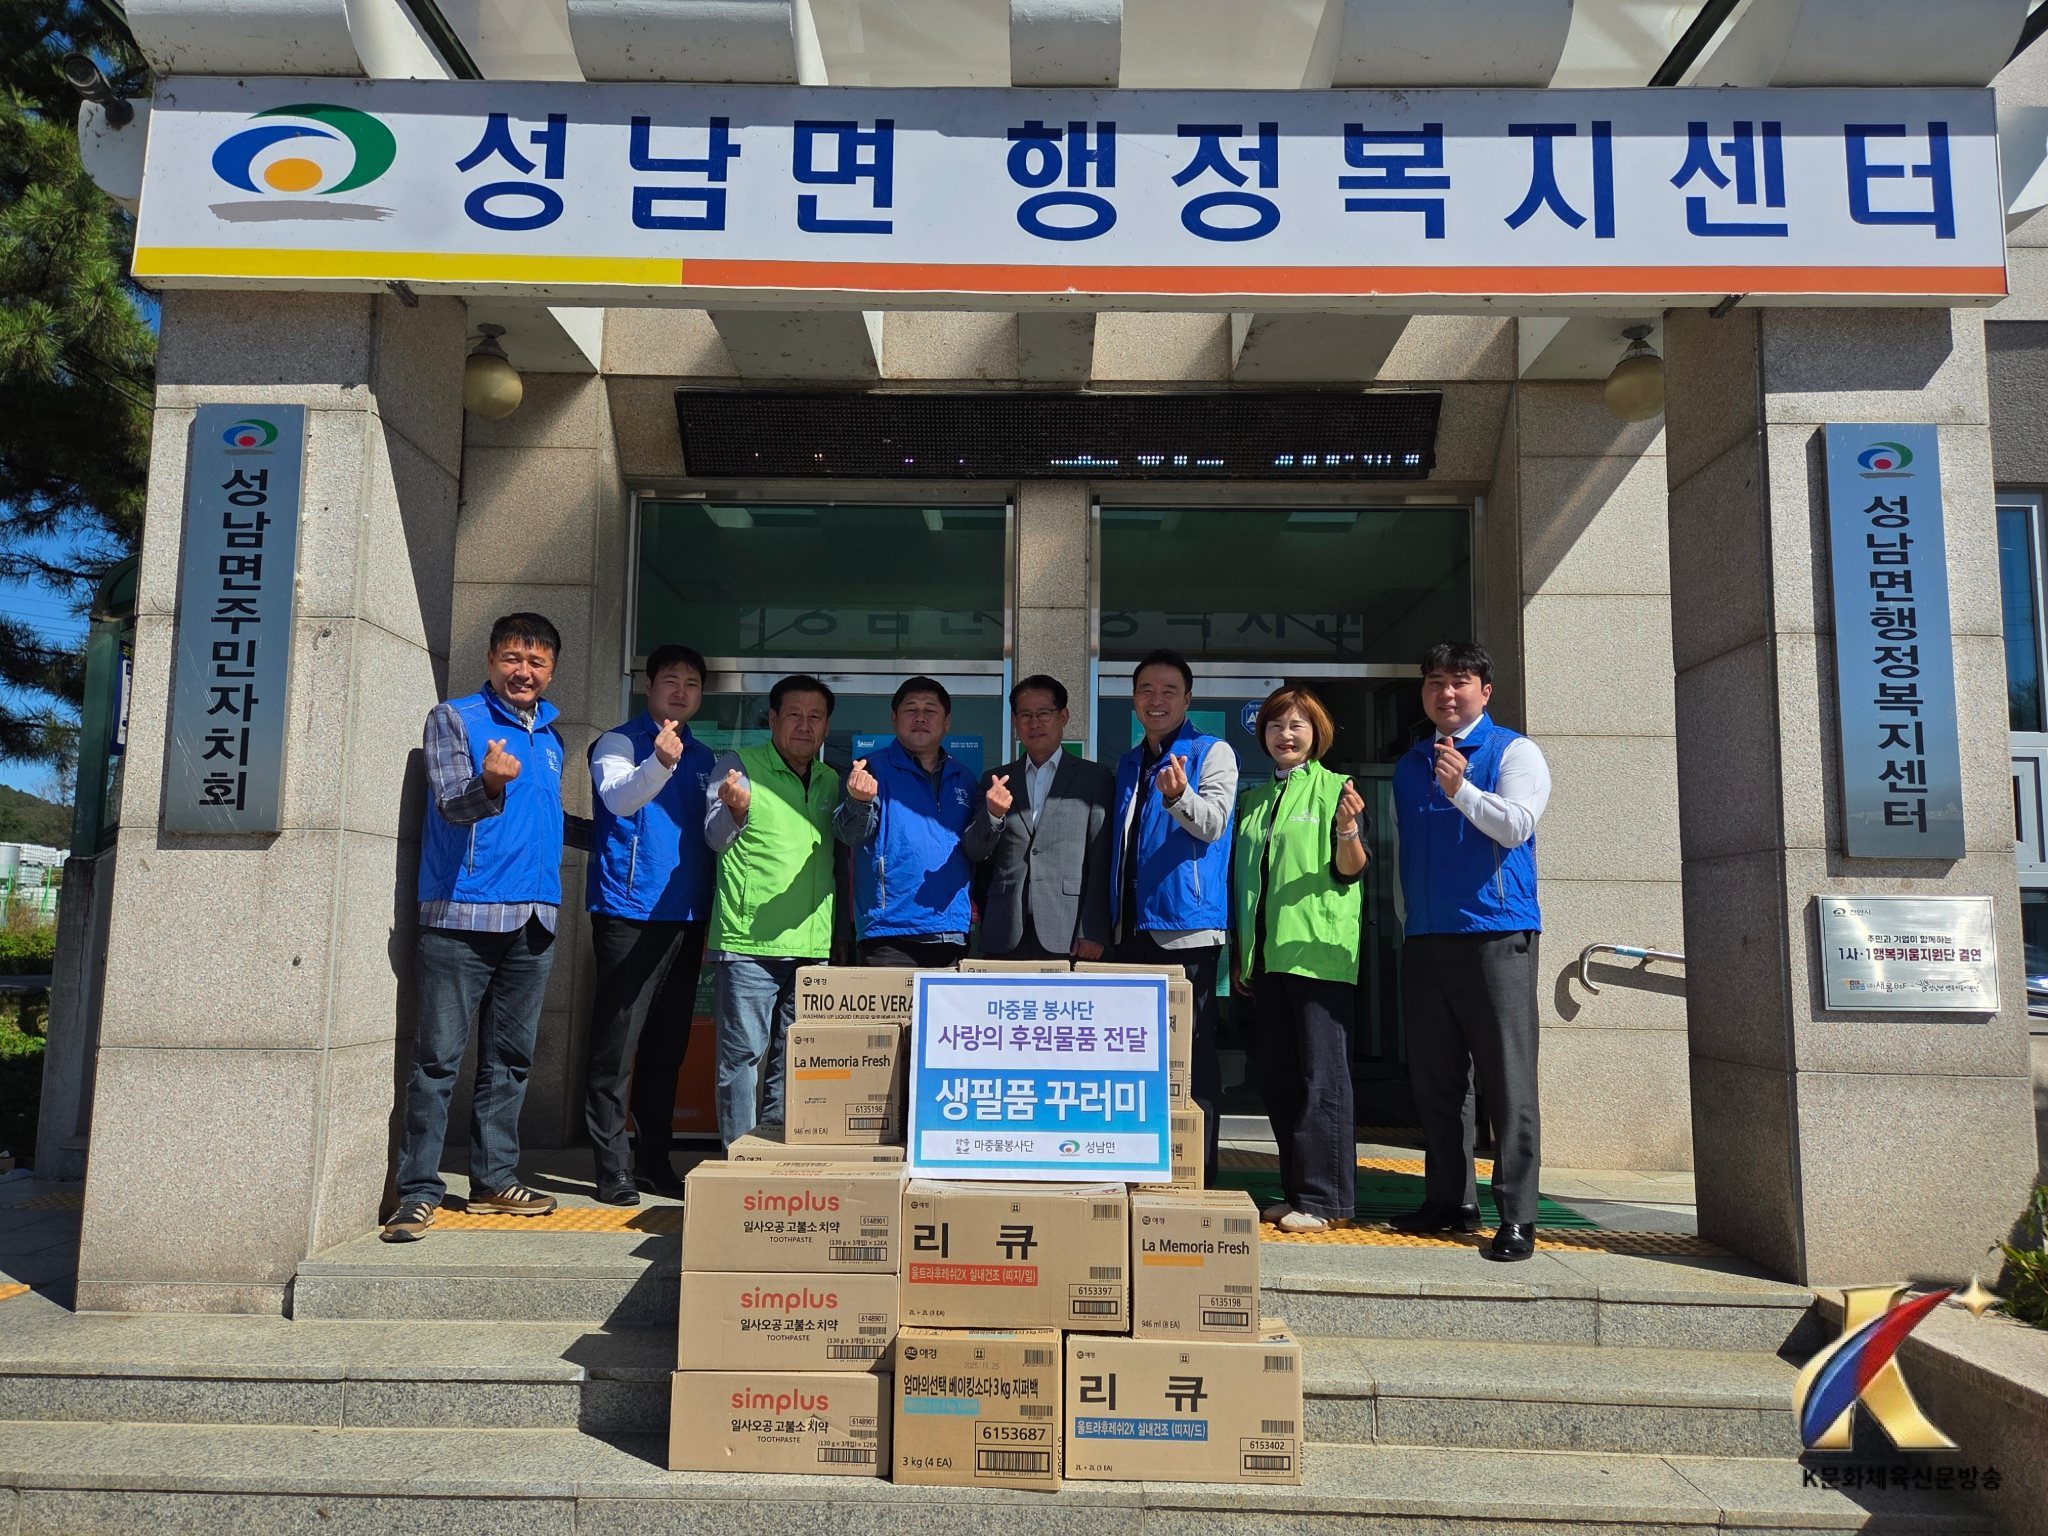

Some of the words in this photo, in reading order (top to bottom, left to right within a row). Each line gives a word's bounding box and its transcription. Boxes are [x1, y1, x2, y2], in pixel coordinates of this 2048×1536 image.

[456, 112, 895, 235] 성남면
[1006, 119, 1957, 242] 행정복지센터
[198, 468, 272, 812] 성남면주민자치회
[1861, 494, 1930, 835] 성남면행정복지센터
[1920, 936, 1952, 944] 함께하는
[1959, 949, 1981, 961] 결연
[803, 994, 834, 1011] TRIO
[839, 995, 876, 1011] ALOE
[988, 1000, 1038, 1020] 마중물
[1043, 1001, 1094, 1020] 봉사단
[938, 1024, 1003, 1051] 사랑의
[1009, 1025, 1098, 1052] 후원물품
[1103, 1026, 1148, 1053] 전달
[794, 1057, 806, 1067] La
[810, 1056, 859, 1067] Memoria
[862, 1055, 890, 1067] Fresh
[935, 1078, 1038, 1121] 생필품
[1045, 1079, 1146, 1122] 꾸러미
[975, 1139, 1034, 1153] 마중물봉사단
[1085, 1141, 1115, 1153] 성남면
[743, 1190, 840, 1216] simplus
[743, 1222, 784, 1233] 일사오공
[786, 1222, 817, 1233] 고불소
[819, 1221, 840, 1233] 치약
[914, 1223, 948, 1258] 리
[996, 1225, 1037, 1260] 큐
[1142, 1239, 1155, 1251] La
[1160, 1240, 1213, 1253] Memoria
[1218, 1241, 1249, 1254] Fresh
[911, 1266, 966, 1280] 울트라후레쉬2X
[970, 1267, 999, 1281] 실내건조
[1078, 1287, 1112, 1295] 6153397
[741, 1287, 838, 1314] simplus
[1211, 1298, 1241, 1306] 6135198
[741, 1319, 782, 1331] 일사오공
[784, 1320, 815, 1331] 고불소
[817, 1319, 838, 1331] 치약
[919, 1349, 937, 1359] 애경
[904, 1375, 947, 1396] 엄마의선택
[949, 1376, 992, 1398] 베이킹소다
[994, 1379, 999, 1393] 3
[1001, 1377, 1010, 1399] kg
[1013, 1378, 1038, 1399] 지퍼백
[1080, 1373, 1116, 1410] 리
[1165, 1376, 1208, 1412] 큐
[731, 1387, 829, 1415] simplus
[731, 1420, 773, 1432] 일사오공
[774, 1421, 806, 1433] 고불소
[808, 1420, 829, 1433] 치약
[983, 1427, 1045, 1440] 6153687
[1077, 1421, 1134, 1435] 울트라후레쉬2X
[1138, 1422, 1169, 1436] 실내건조
[1250, 1441, 1285, 1450] 6153402
[903, 1457, 908, 1465] 3
[911, 1457, 922, 1468] kg
[925, 1457, 933, 1467] (4
[937, 1458, 952, 1467] EA)
